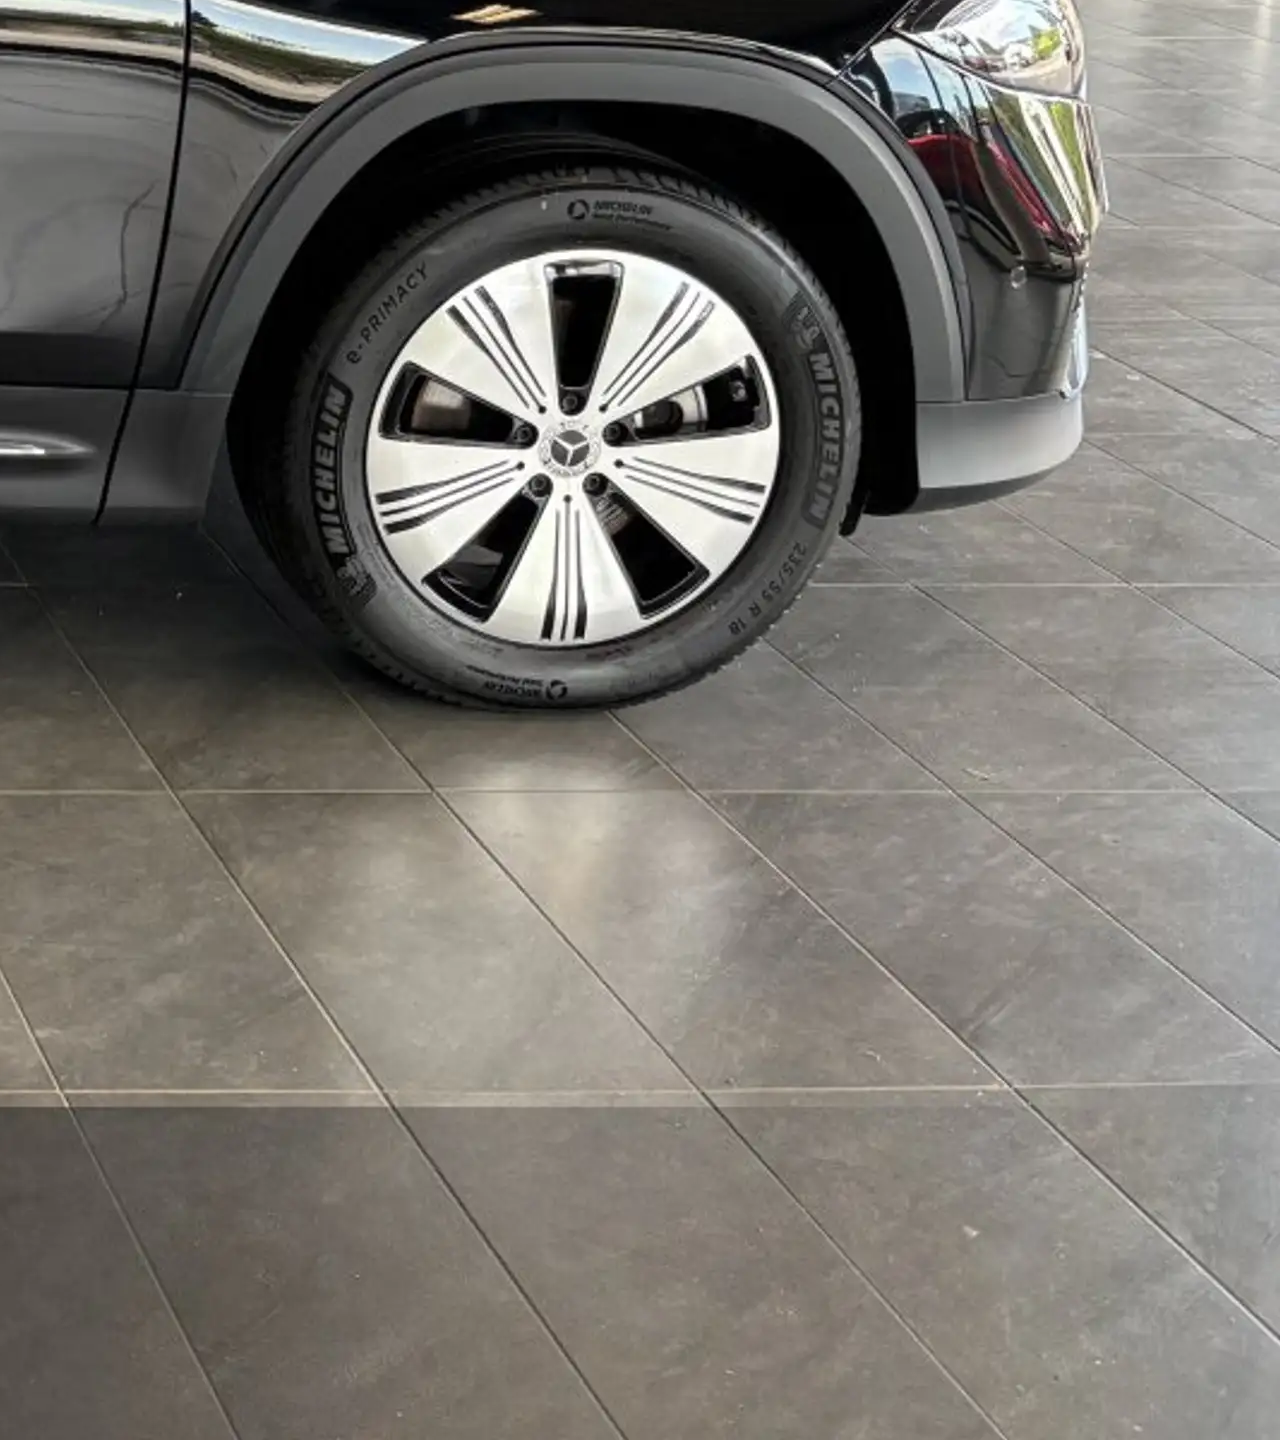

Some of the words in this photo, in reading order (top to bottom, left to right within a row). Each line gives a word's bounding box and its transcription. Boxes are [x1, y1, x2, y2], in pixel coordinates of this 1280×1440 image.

[346, 261, 428, 364] e-PRIMACY
[314, 382, 350, 556] MICHELIN
[807, 352, 841, 521] MICHELIN
